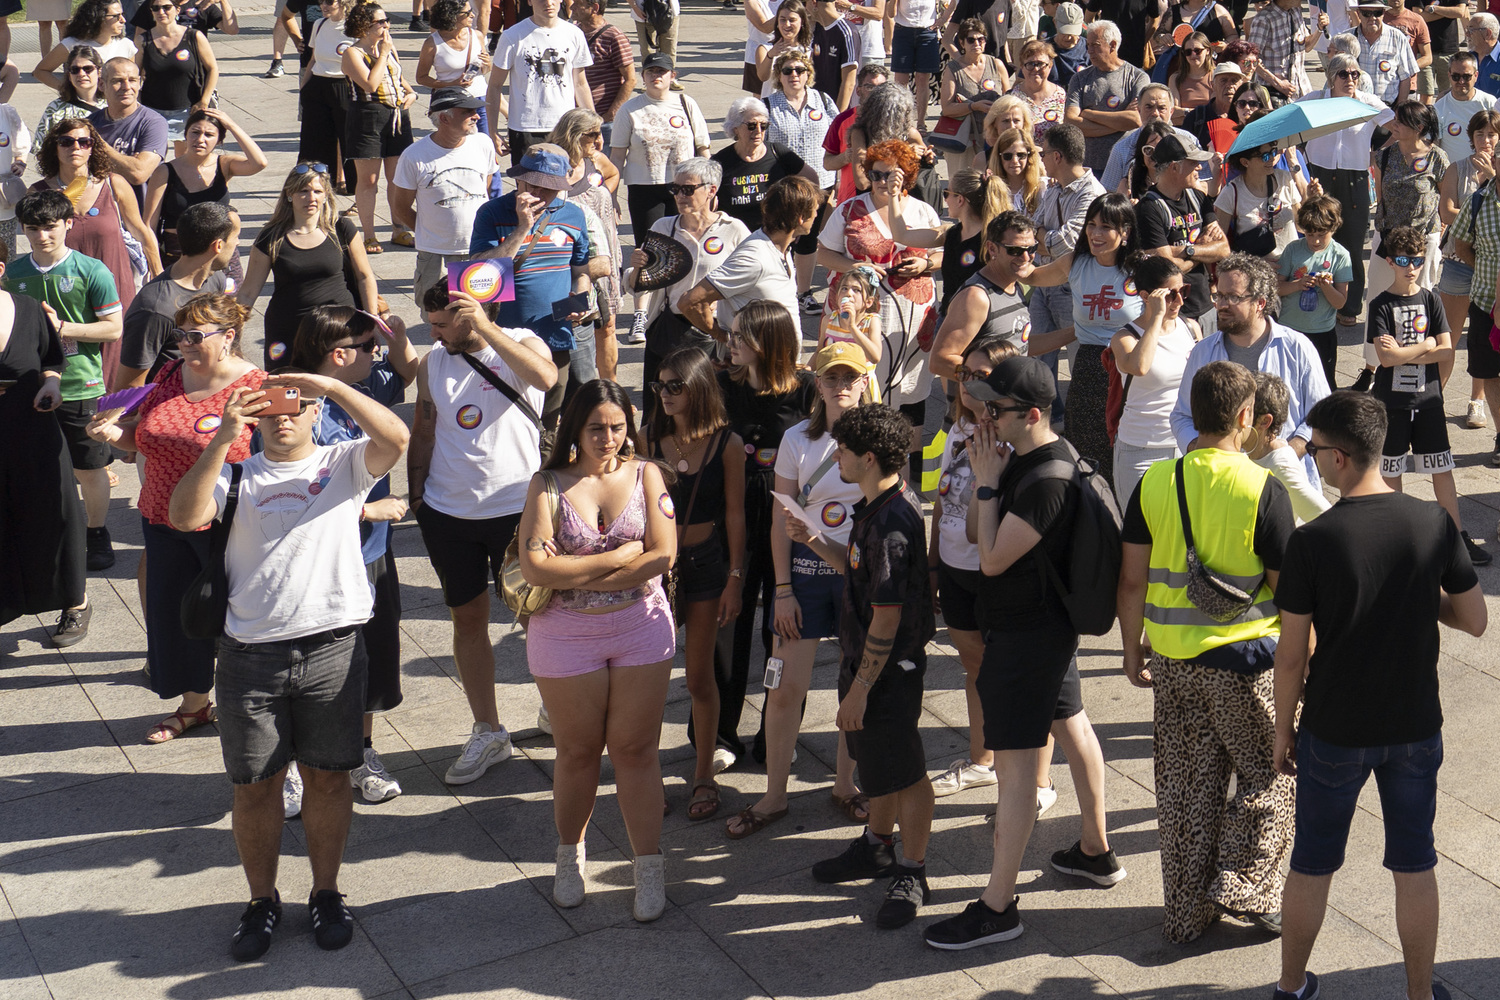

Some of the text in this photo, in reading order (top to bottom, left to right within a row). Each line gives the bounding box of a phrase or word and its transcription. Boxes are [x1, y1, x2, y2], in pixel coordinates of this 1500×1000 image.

[732, 173, 770, 186] euskaraz
[742, 184, 759, 195] bizi
[731, 195, 751, 205] nahi
[1382, 450, 1453, 473] BEST EVENT
[792, 557, 818, 568] PACIFIC
[791, 565, 816, 576] STREET
